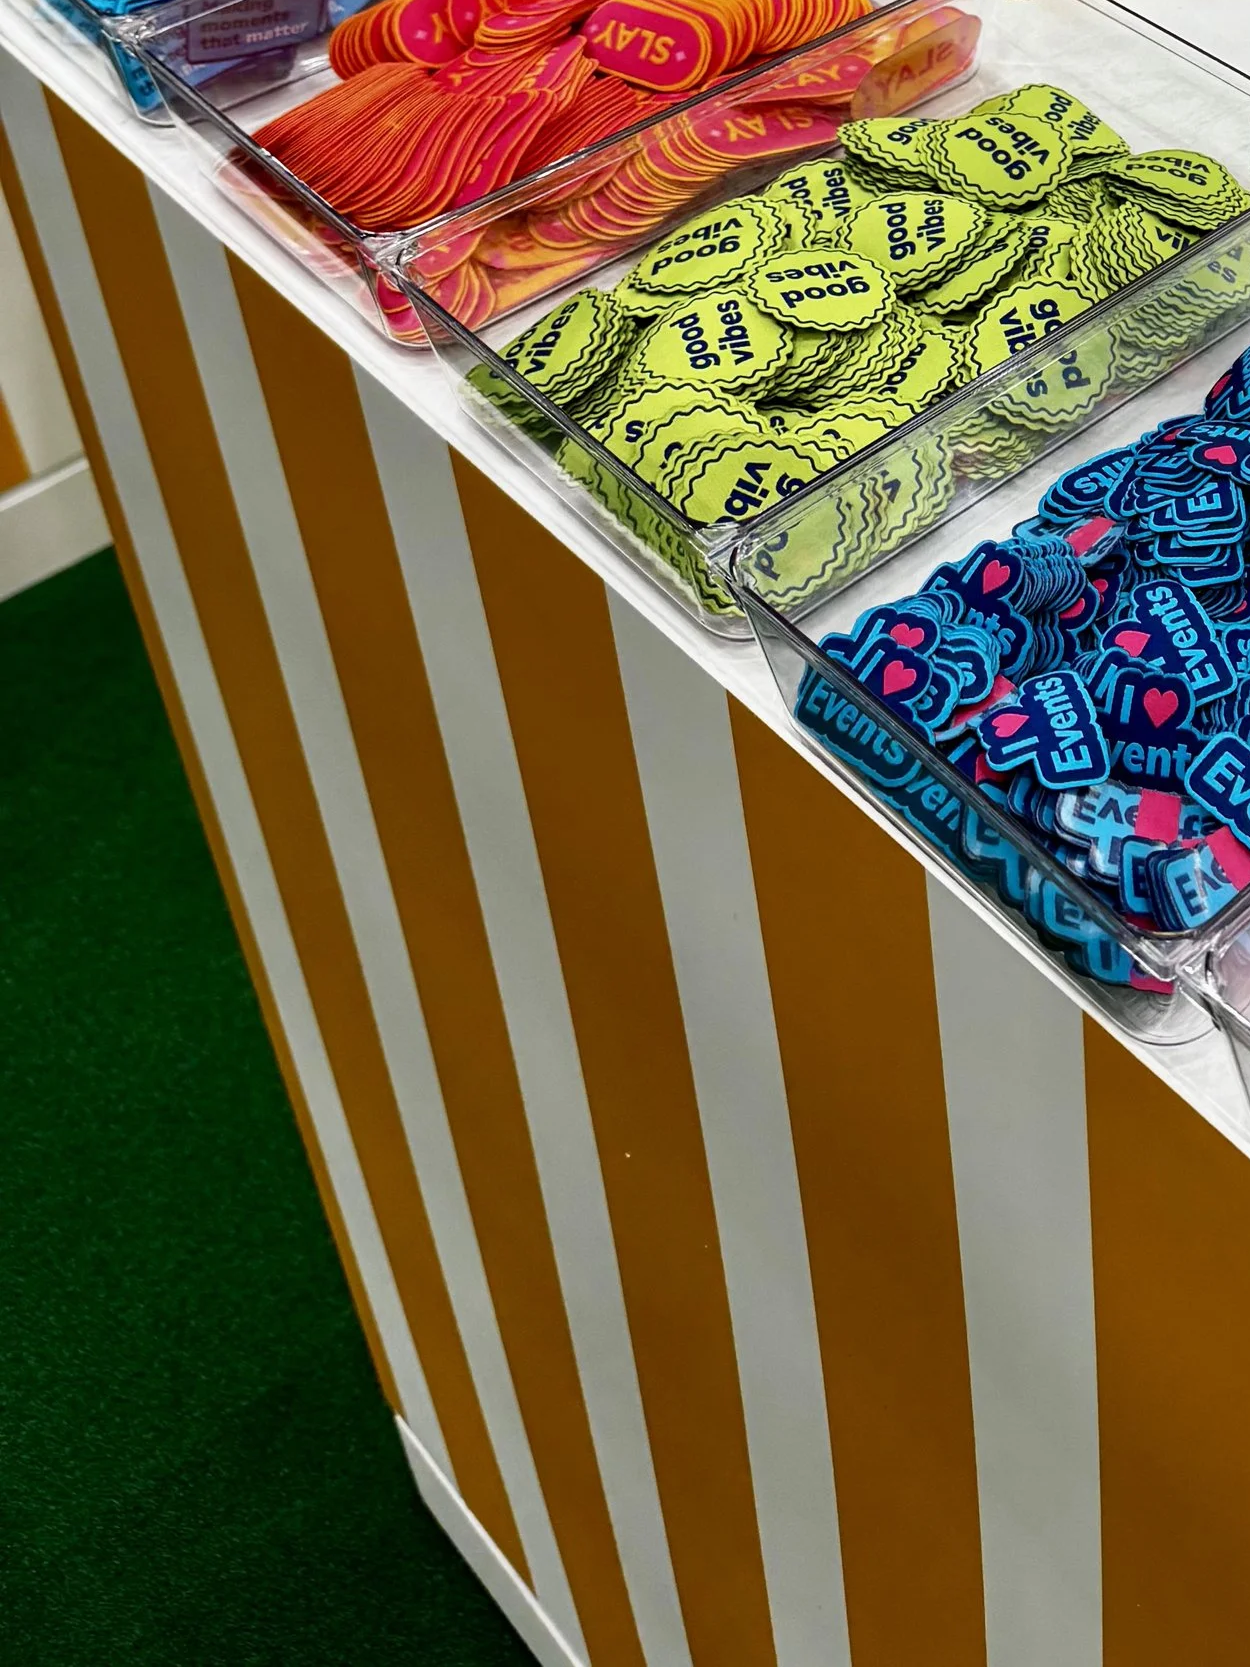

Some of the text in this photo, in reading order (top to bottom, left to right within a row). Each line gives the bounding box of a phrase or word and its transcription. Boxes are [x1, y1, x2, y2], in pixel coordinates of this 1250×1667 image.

[592, 19, 675, 65] SLAY
[954, 127, 1032, 181] good
[985, 116, 1050, 166] vibes
[657, 216, 744, 253] vibes
[879, 201, 916, 261] good
[917, 199, 947, 253] vibes
[651, 235, 741, 276] good
[765, 260, 860, 283] vibes
[780, 275, 870, 309] good
[670, 312, 721, 370] good
[716, 299, 754, 367] vibes
[1146, 585, 1221, 691] Events
[806, 682, 909, 765] Events
[1002, 735, 1039, 755] I
[1034, 676, 1093, 773] Events
